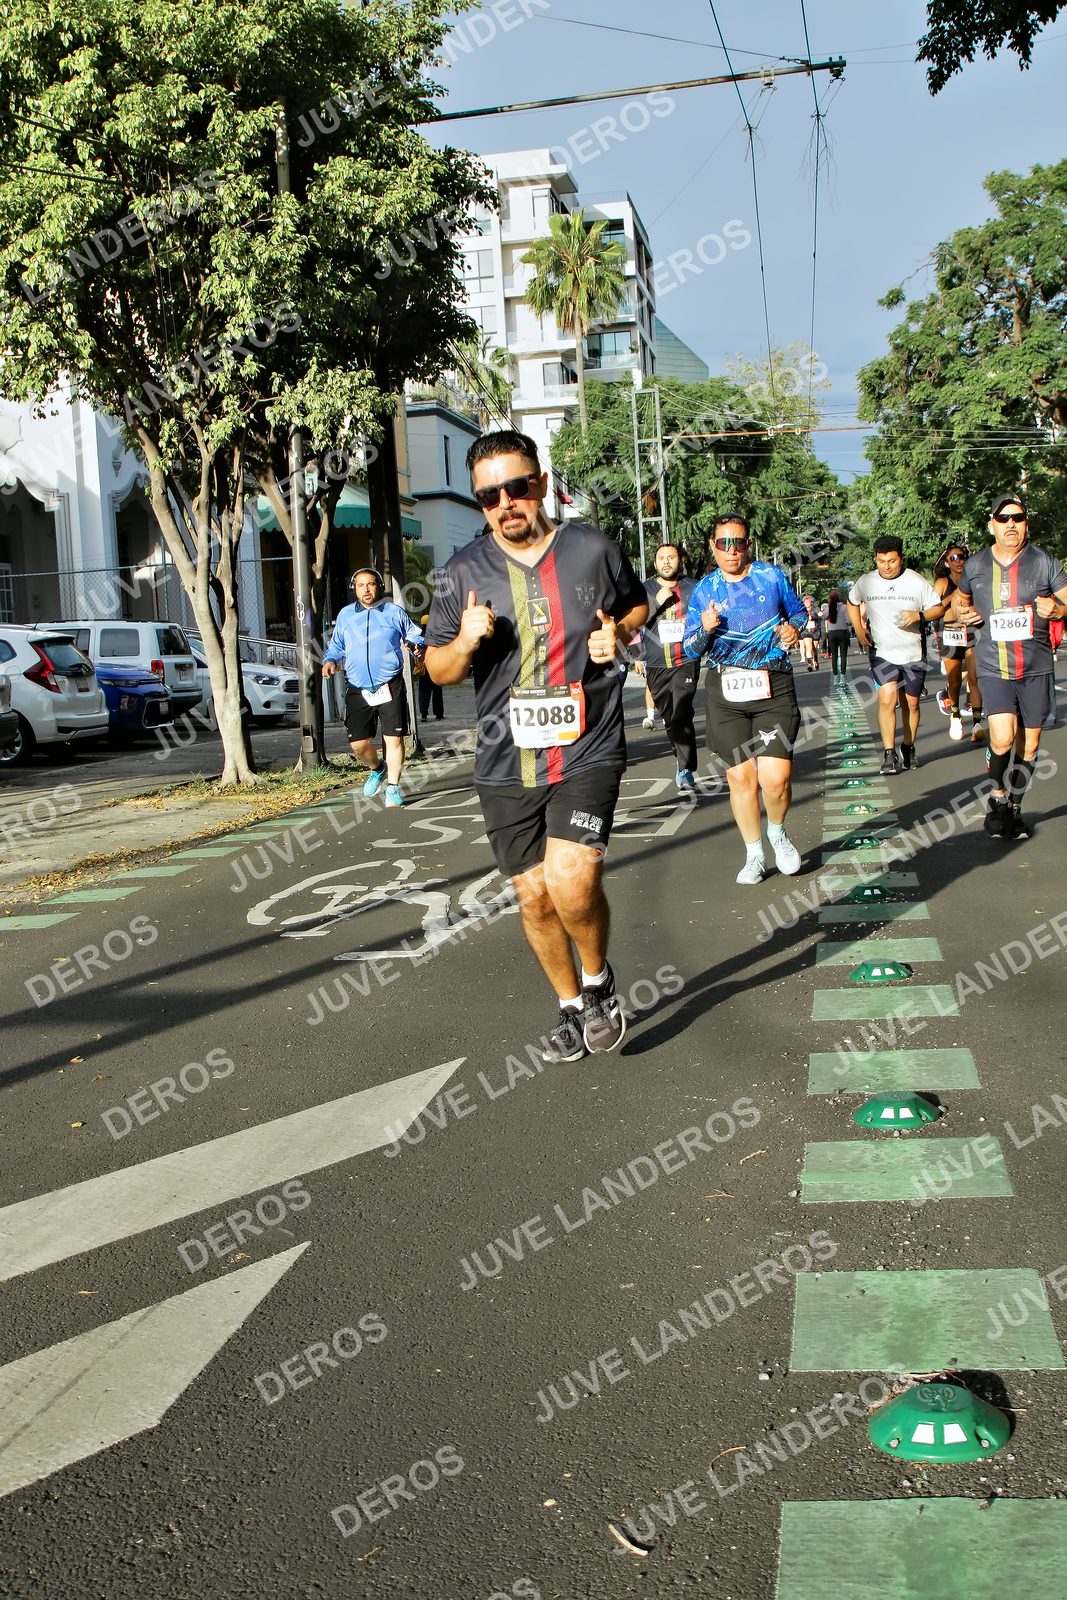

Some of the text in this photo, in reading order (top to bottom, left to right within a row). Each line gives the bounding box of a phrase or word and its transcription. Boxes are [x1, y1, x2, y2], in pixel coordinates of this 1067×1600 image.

[993, 617, 1028, 629] 12862
[726, 676, 763, 691] 12716
[512, 704, 576, 727] 12088
[571, 809, 591, 822] LOVE
[570, 817, 601, 834] PEACE
